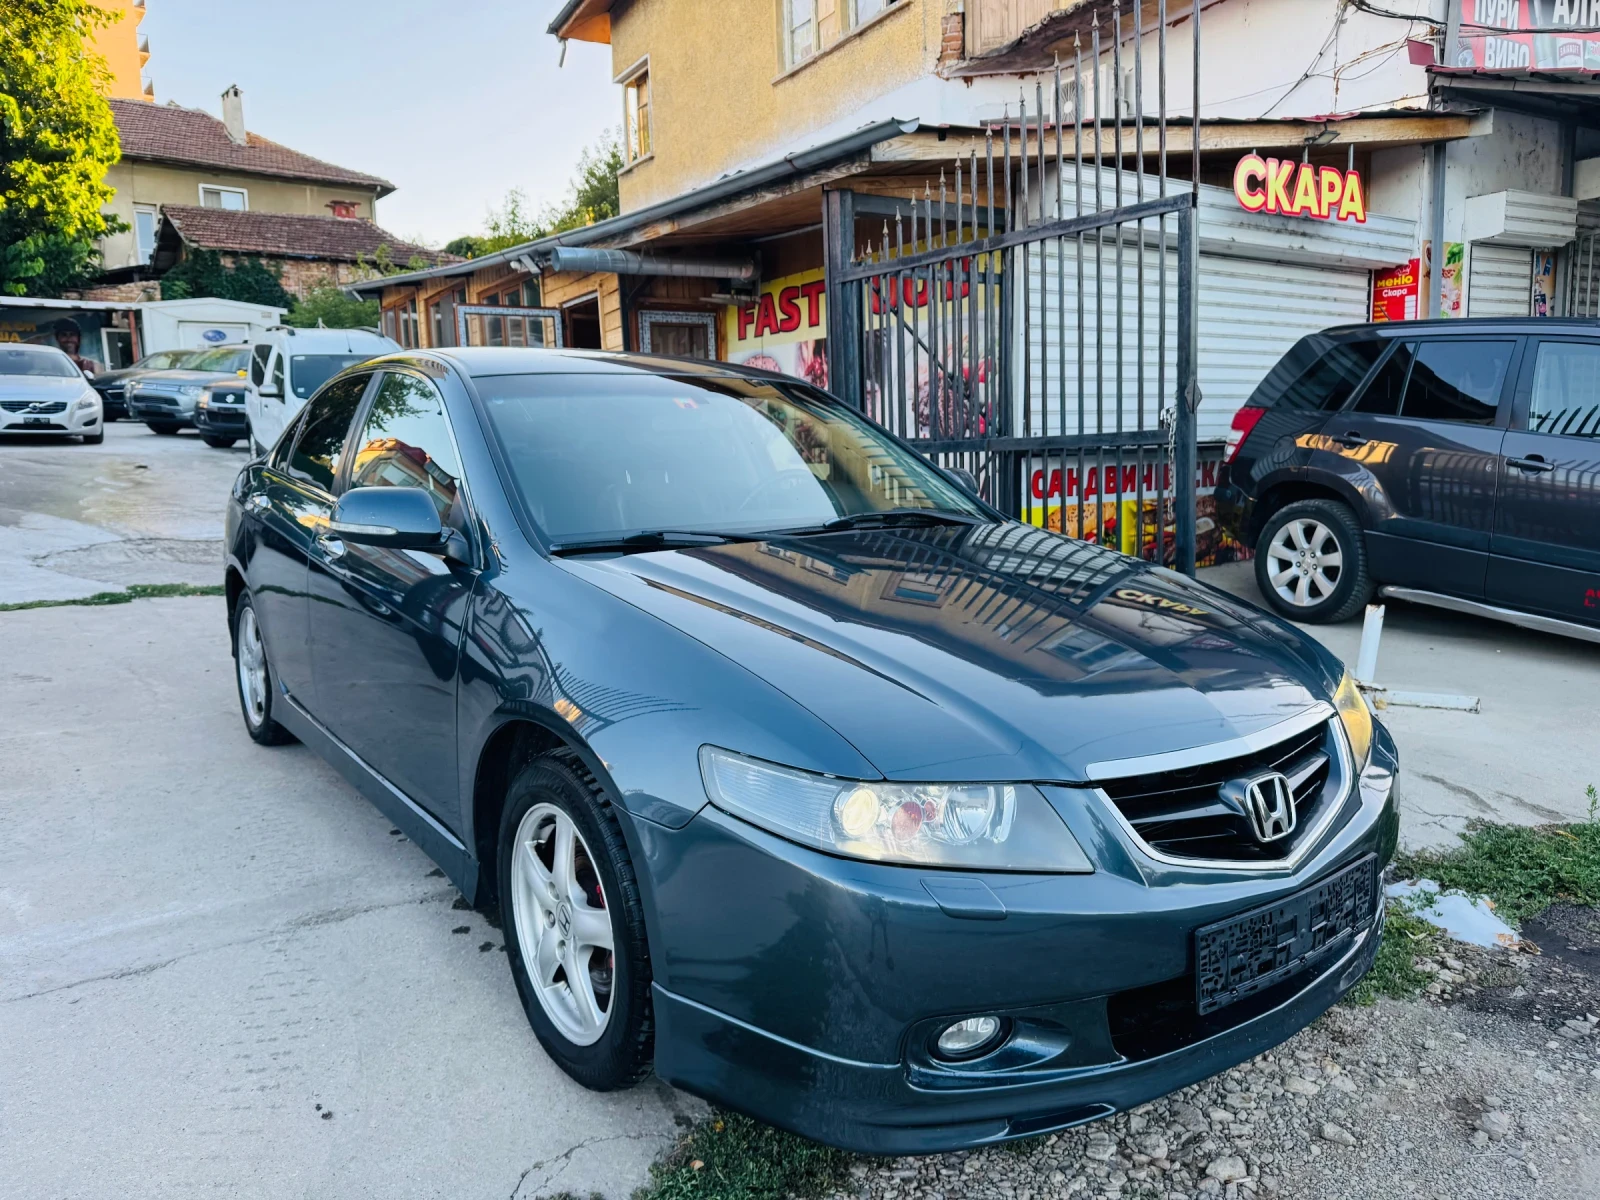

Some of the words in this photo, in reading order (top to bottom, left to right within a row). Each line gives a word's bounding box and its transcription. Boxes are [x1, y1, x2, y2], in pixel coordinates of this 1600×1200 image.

[1485, 36, 1529, 68] ВИНО
[1234, 154, 1366, 223] СКАРА
[738, 279, 825, 340] FAST
